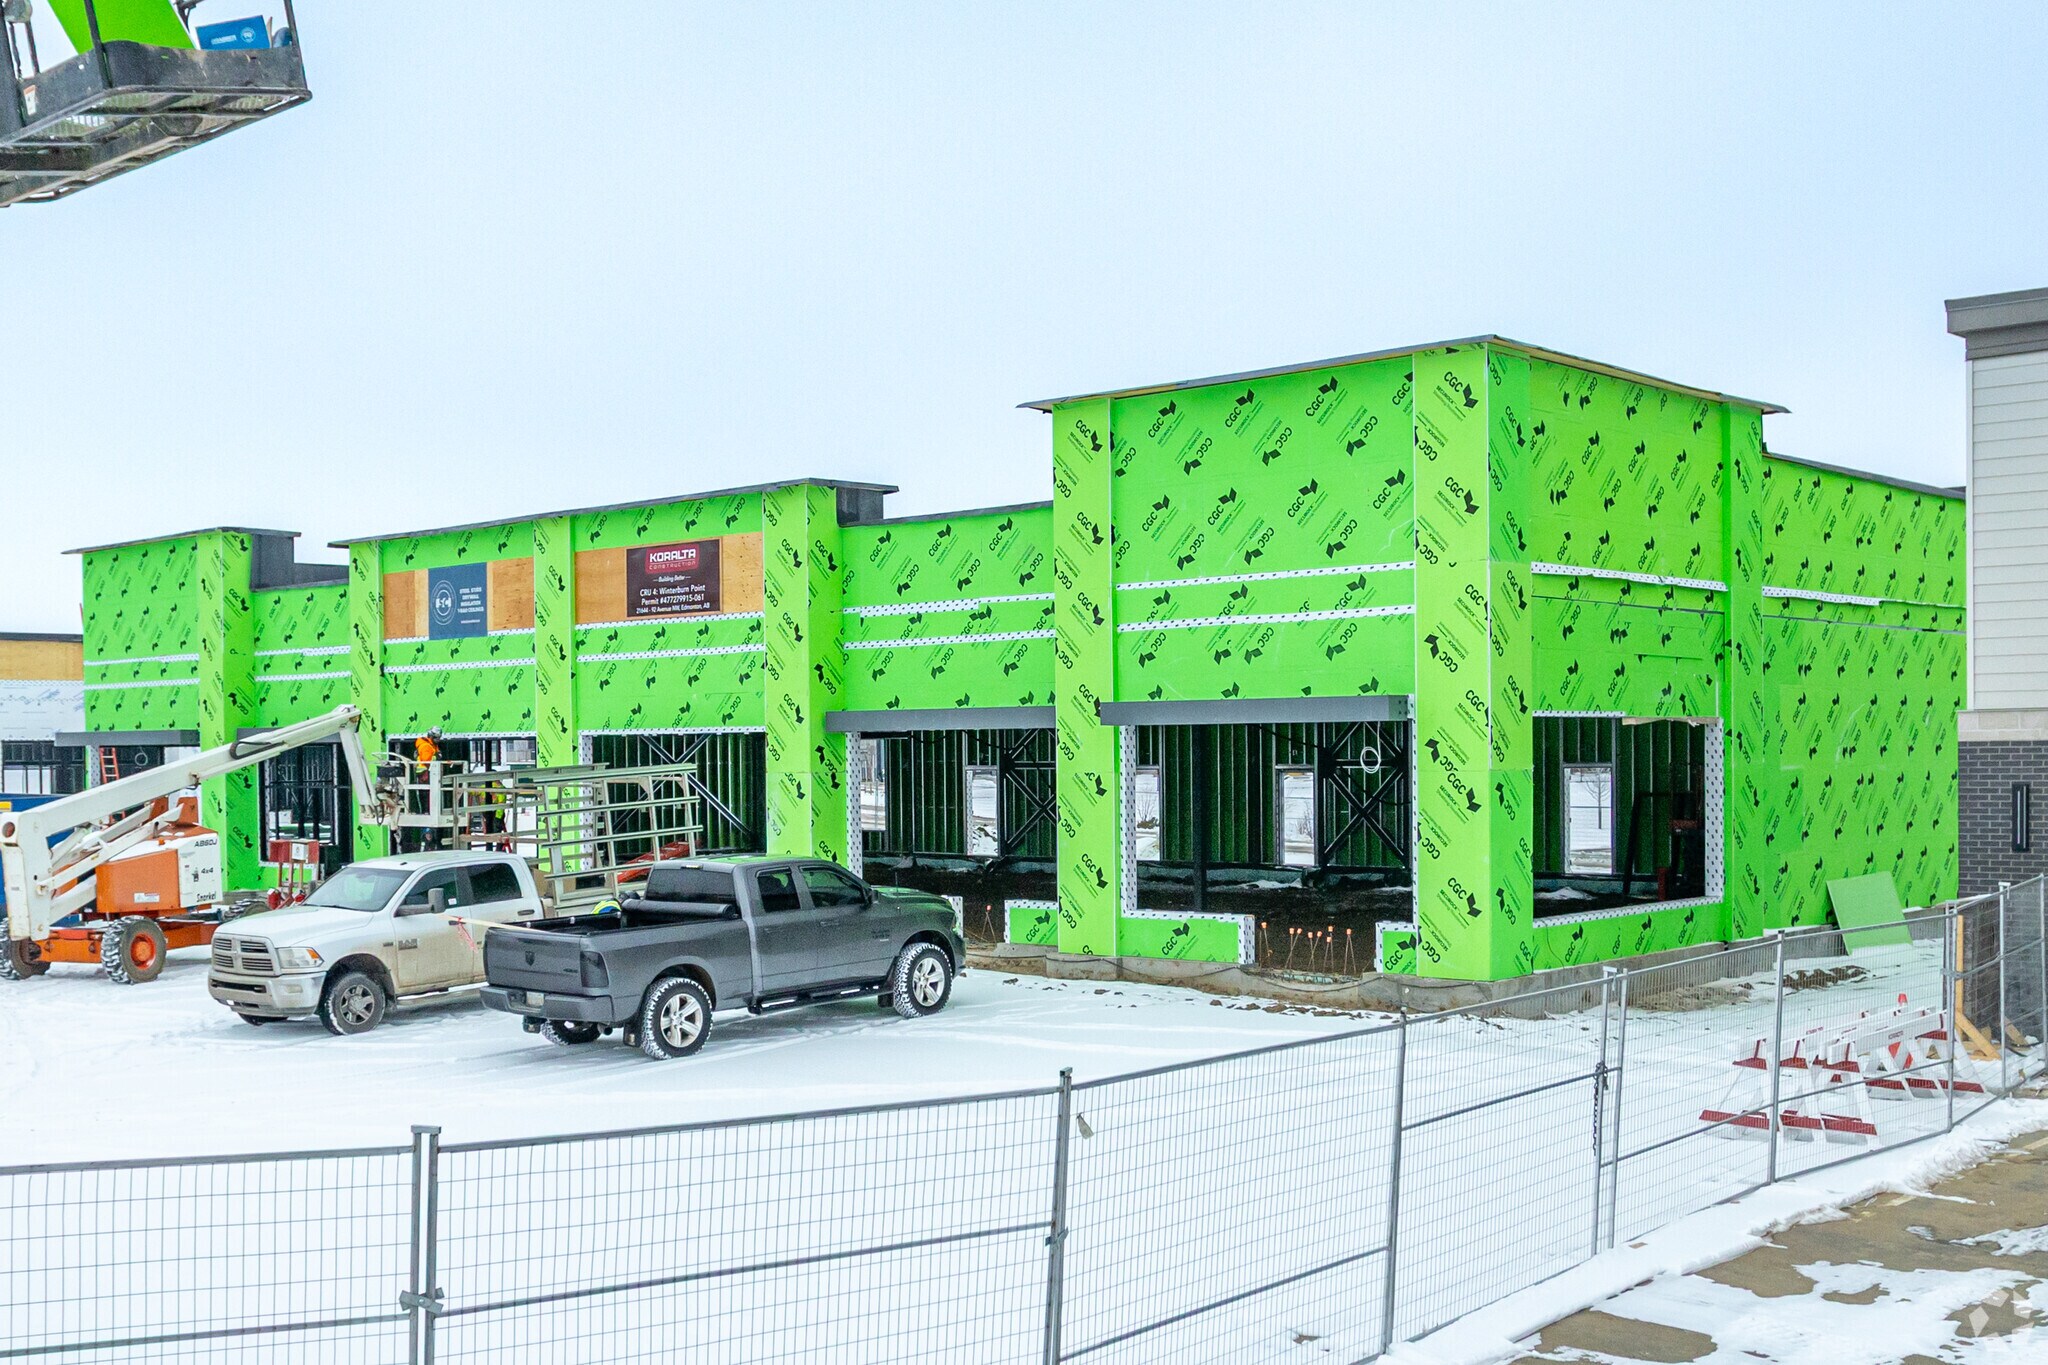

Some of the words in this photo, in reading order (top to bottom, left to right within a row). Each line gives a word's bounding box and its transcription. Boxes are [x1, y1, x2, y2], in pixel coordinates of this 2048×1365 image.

[1444, 372, 1463, 392] CGC
[1490, 363, 1501, 386] CGC
[1392, 383, 1410, 405] CGC
[1589, 377, 1598, 395] CGC
[1306, 394, 1324, 416] CGC
[1636, 388, 1644, 406] CGC
[1225, 406, 1241, 427] CGC
[1506, 406, 1517, 428] CGC
[1699, 403, 1709, 421] CGC
[1076, 420, 1090, 438] CGC
[1148, 418, 1164, 437] CGC
[1360, 416, 1378, 438] CGC
[1276, 427, 1292, 448] CGC
[1121, 448, 1136, 467] CGC
[1196, 438, 1212, 458] CGC
[1419, 441, 1437, 461] CGC
[1582, 446, 1592, 465] CGC
[1629, 455, 1638, 473] CGC
[1671, 464, 1680, 481] CGC
[1056, 480, 1071, 498] CGC
[1445, 477, 1464, 498] CGC
[1490, 470, 1502, 491] CGC
[1564, 471, 1574, 490] CGC
[1612, 479, 1622, 497] CGC
[1373, 488, 1391, 509] CGC
[1655, 486, 1664, 504] CGC
[1696, 493, 1705, 511] CGC
[1208, 505, 1223, 525] CGC
[1288, 497, 1304, 517] CGC
[766, 512, 777, 526] CGC
[1077, 512, 1092, 530] CGC
[1142, 512, 1158, 531] CGC
[1507, 511, 1518, 533] CGC
[1258, 528, 1274, 548] CGC
[1340, 520, 1357, 540] CGC
[782, 539, 793, 555] CGC
[815, 540, 828, 557] CGC
[929, 539, 941, 556] CGC
[989, 533, 1003, 552] CGC
[1117, 541, 1130, 560] CGC
[1190, 534, 1204, 554] CGC
[1557, 541, 1568, 560] CGC
[650, 549, 696, 562] KORALTA
[870, 545, 882, 562] CGC
[1030, 553, 1043, 572] CGC
[1419, 545, 1438, 564] CGC
[1593, 545, 1602, 564] CGC
[1638, 551, 1648, 569] CGC
[907, 564, 919, 581] CGC
[968, 559, 980, 577] CGC
[1686, 557, 1694, 574] CGC
[658, 575, 674, 583] Building
[674, 574, 685, 582] Better
[843, 571, 854, 588] CGC
[1058, 571, 1072, 589] CGC
[1507, 570, 1518, 592] CGC
[640, 589, 652, 597] CRU
[659, 586, 689, 595] Winterburn
[690, 584, 706, 592] Point
[767, 593, 778, 607] CGC
[1464, 584, 1484, 605] CGC
[641, 597, 659, 605] Permit
[681, 603, 702, 611] Edmonton,
[1078, 592, 1093, 611] CGC
[783, 613, 794, 629] CGC
[1571, 605, 1581, 625] CGC
[1257, 628, 1274, 648] CGC
[1340, 623, 1357, 643] CGC
[1150, 633, 1166, 653] CGC
[1492, 635, 1504, 657] CGC
[881, 651, 893, 668] CGC
[941, 648, 953, 665] CGC
[1014, 644, 1028, 663] CGC
[1058, 651, 1073, 669] CGC
[1439, 652, 1458, 672] CGC
[768, 665, 779, 680] CGC
[824, 678, 836, 694] CGC
[1078, 684, 1094, 703] CGC
[1508, 675, 1519, 697] CGC
[1561, 676, 1570, 696] CGC
[1608, 678, 1617, 697] CGC
[784, 694, 795, 710] CGC
[1466, 690, 1484, 711] CGC
[769, 747, 780, 761] CGC
[1059, 740, 1074, 760] CGC
[1492, 739, 1504, 762] CGC
[1447, 772, 1466, 794] CGC
[1504, 799, 1515, 820] CGC
[1061, 820, 1075, 838] CGC
[819, 841, 831, 857] CGC
[1422, 838, 1440, 859] CGC
[1520, 838, 1530, 858] CGC
[1082, 854, 1096, 873] CGC
[1448, 878, 1466, 899] CGC
[1062, 909, 1076, 929] CGC
[1504, 903, 1516, 925] CGC
[1162, 937, 1177, 955] CGC
[1636, 932, 1644, 951] CGC
[1384, 950, 1403, 971] CGC
[1422, 941, 1440, 963] CGC
[1520, 941, 1531, 962] CGC
[1565, 942, 1575, 962] CGC
